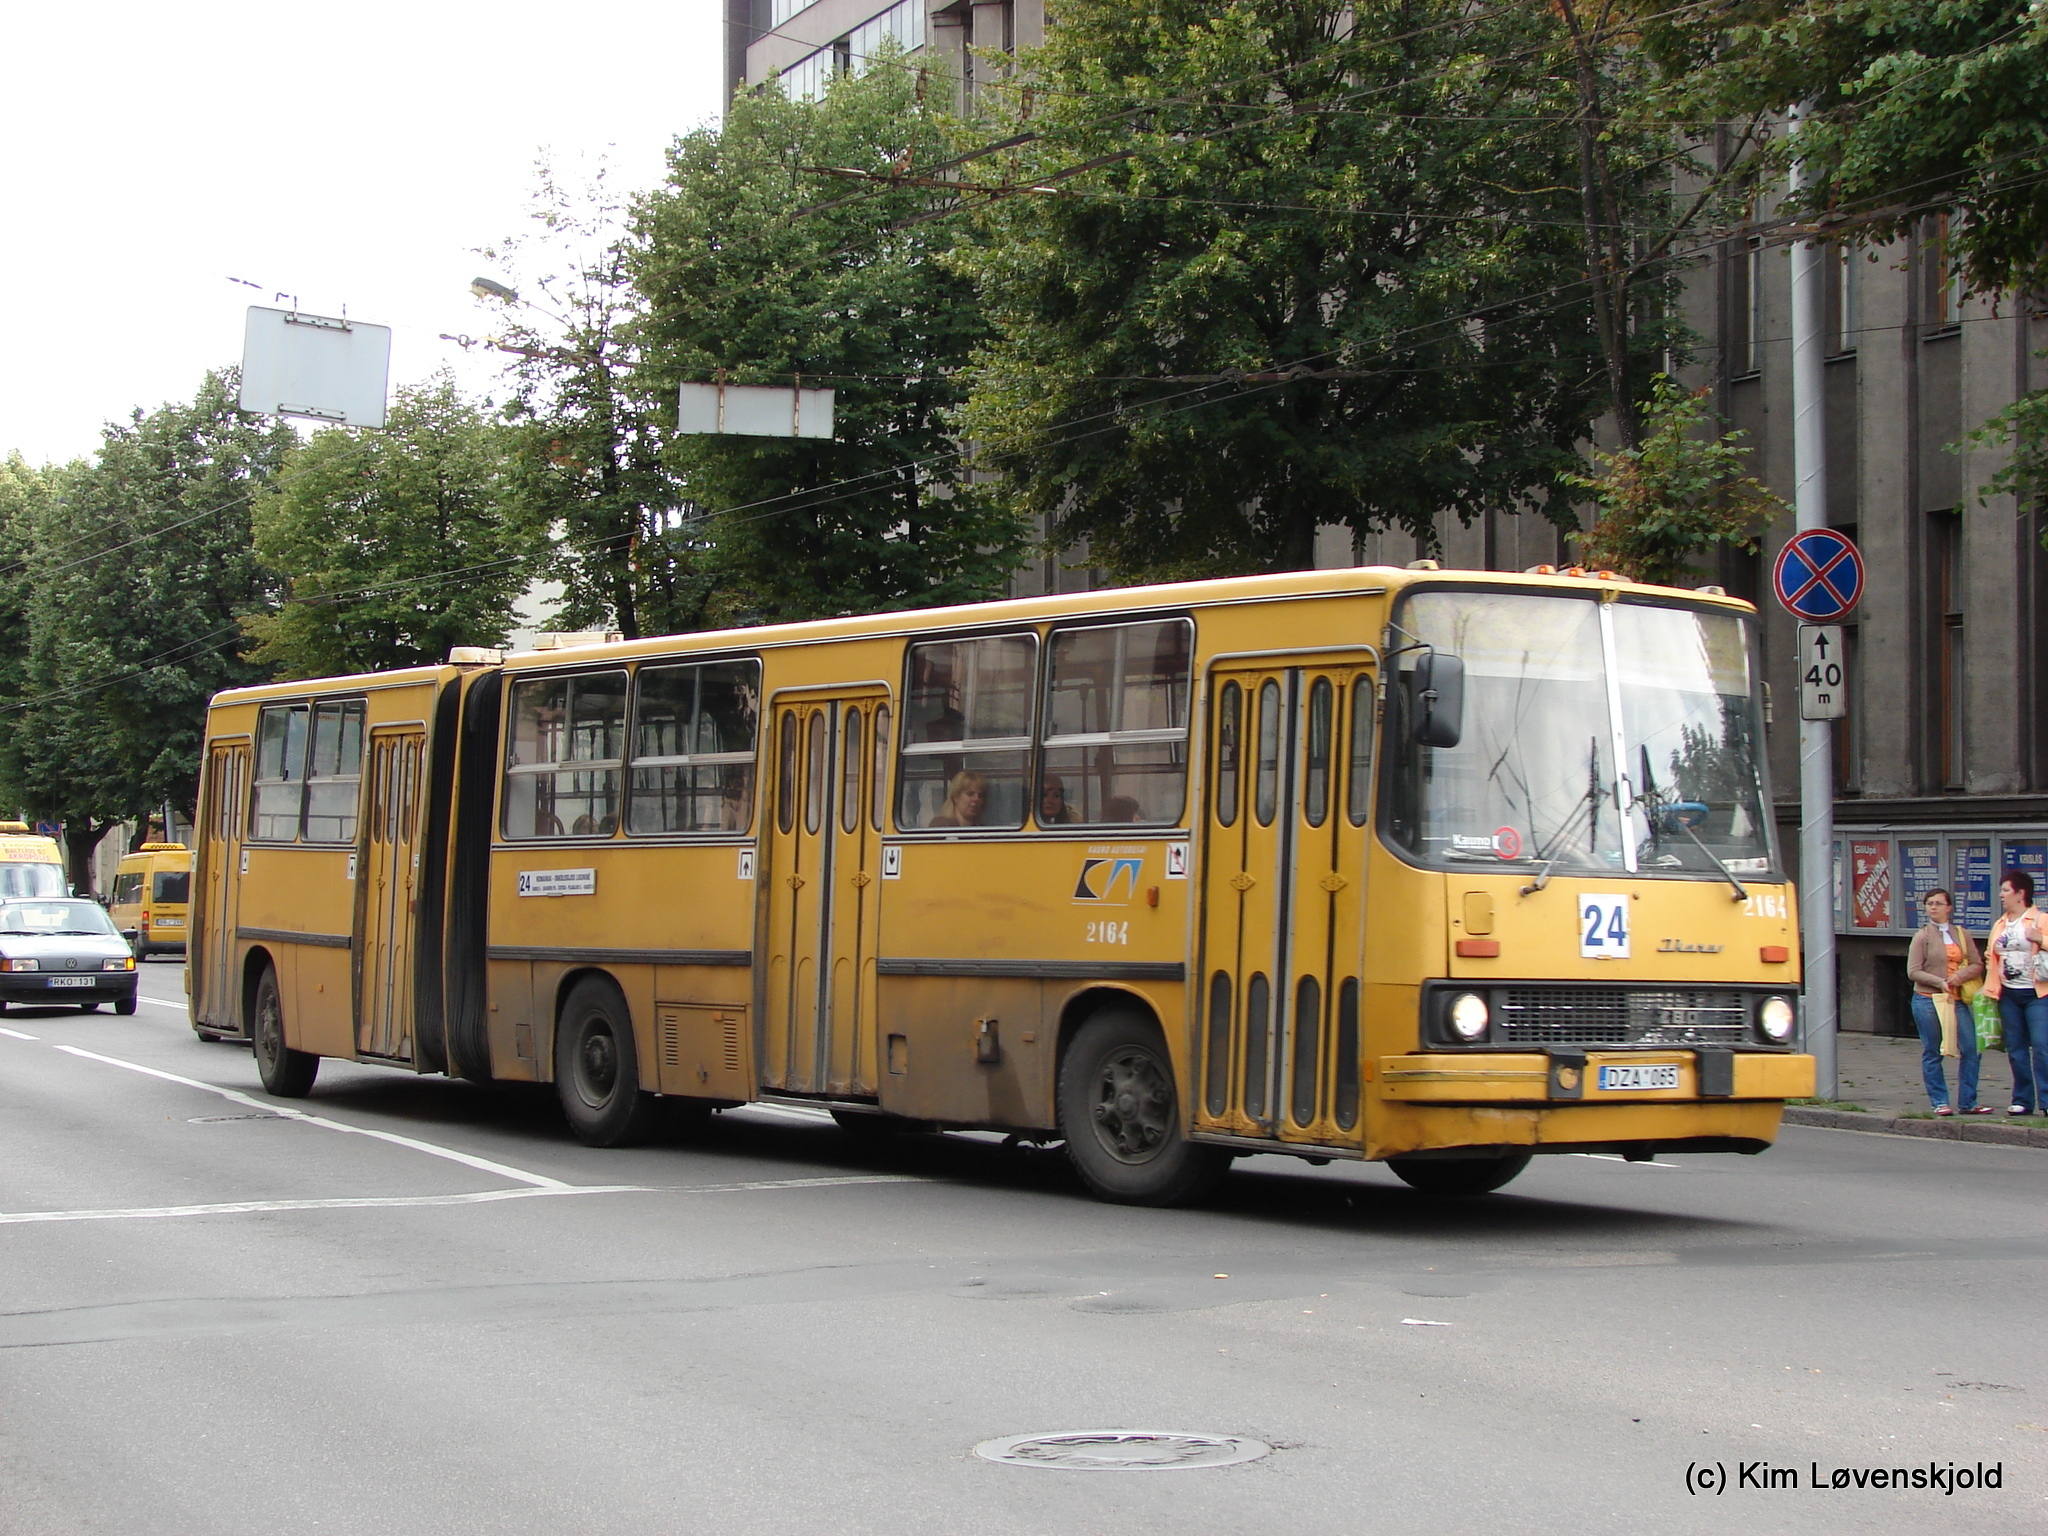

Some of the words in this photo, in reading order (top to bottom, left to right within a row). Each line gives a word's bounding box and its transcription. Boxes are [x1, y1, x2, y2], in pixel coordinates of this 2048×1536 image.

[1804, 663, 1842, 688] 40
[1818, 693, 1831, 704] m
[520, 874, 530, 892] 24
[1743, 894, 1787, 919] 2164
[1086, 921, 1129, 945] 2164
[1585, 904, 1628, 947] 24
[53, 977, 73, 986] RKO
[79, 977, 94, 986] 131
[1608, 1068, 1641, 1087] DZA
[1650, 1067, 1676, 1086] 065
